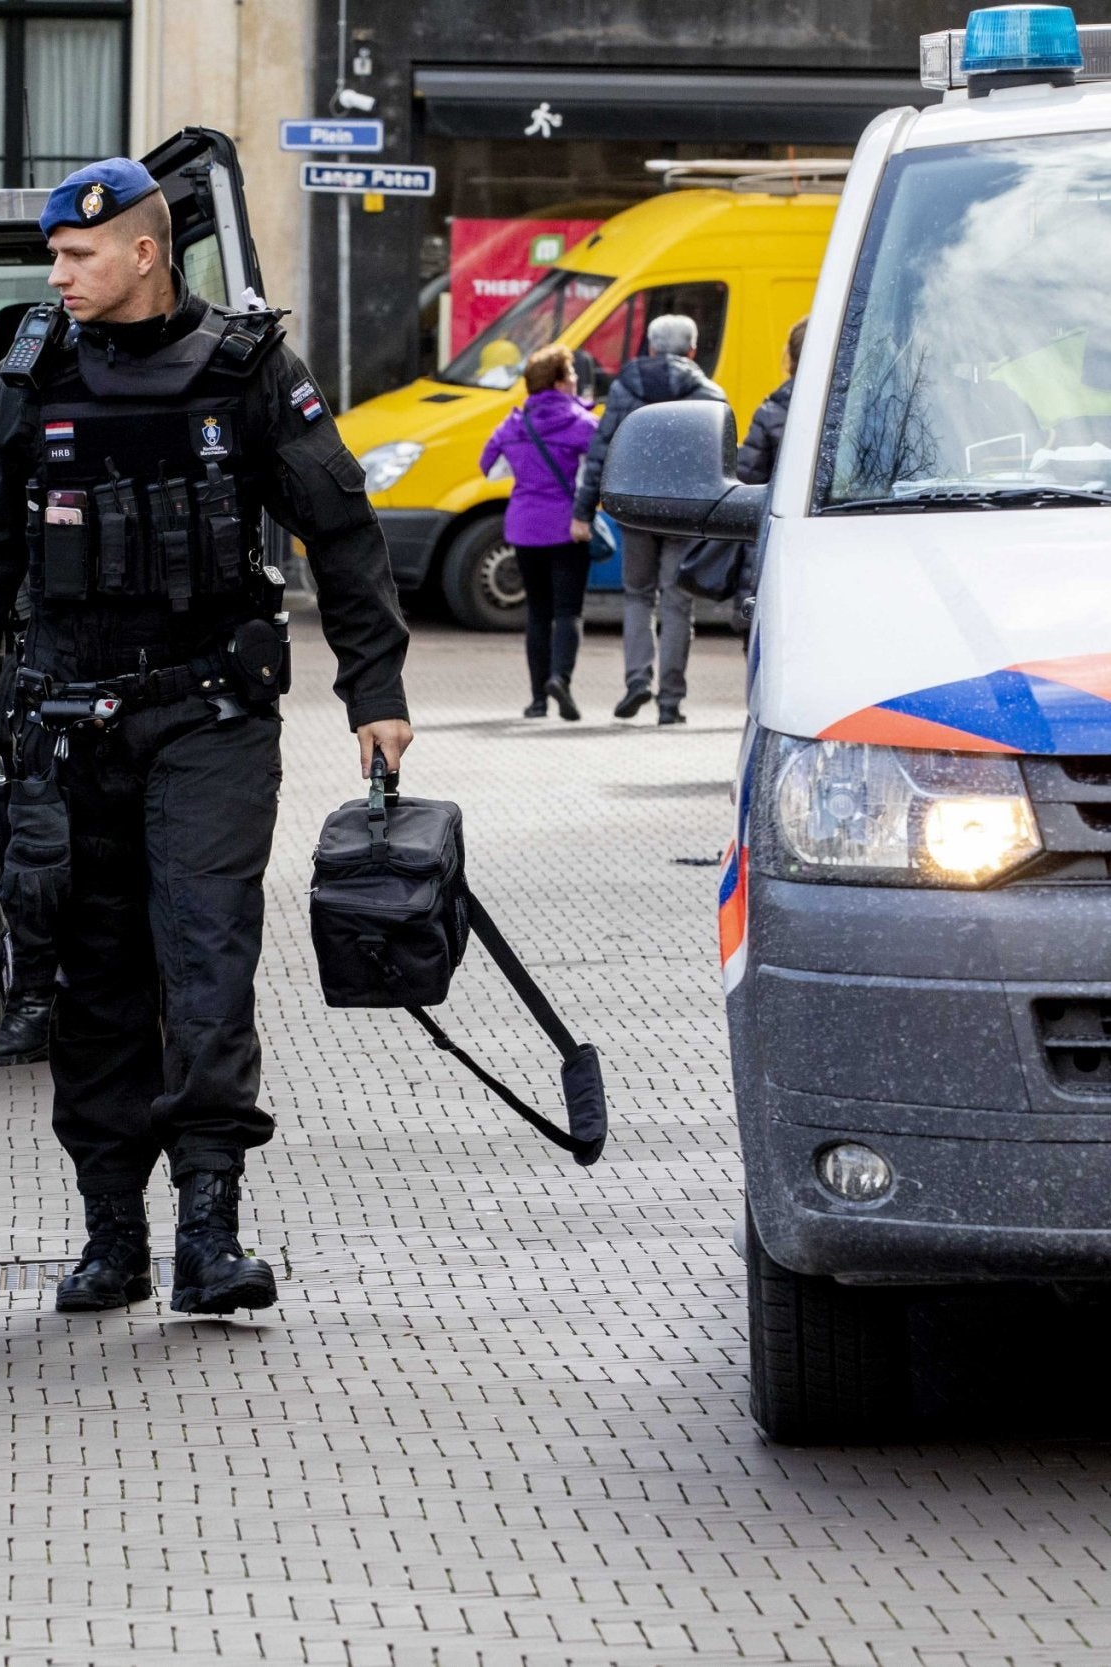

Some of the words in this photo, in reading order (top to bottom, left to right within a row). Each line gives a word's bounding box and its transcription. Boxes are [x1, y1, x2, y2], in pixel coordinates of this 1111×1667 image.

[309, 127, 354, 144] Plein
[309, 168, 367, 187] Lange
[371, 170, 426, 188] Poten
[51, 449, 71, 458] HRB
